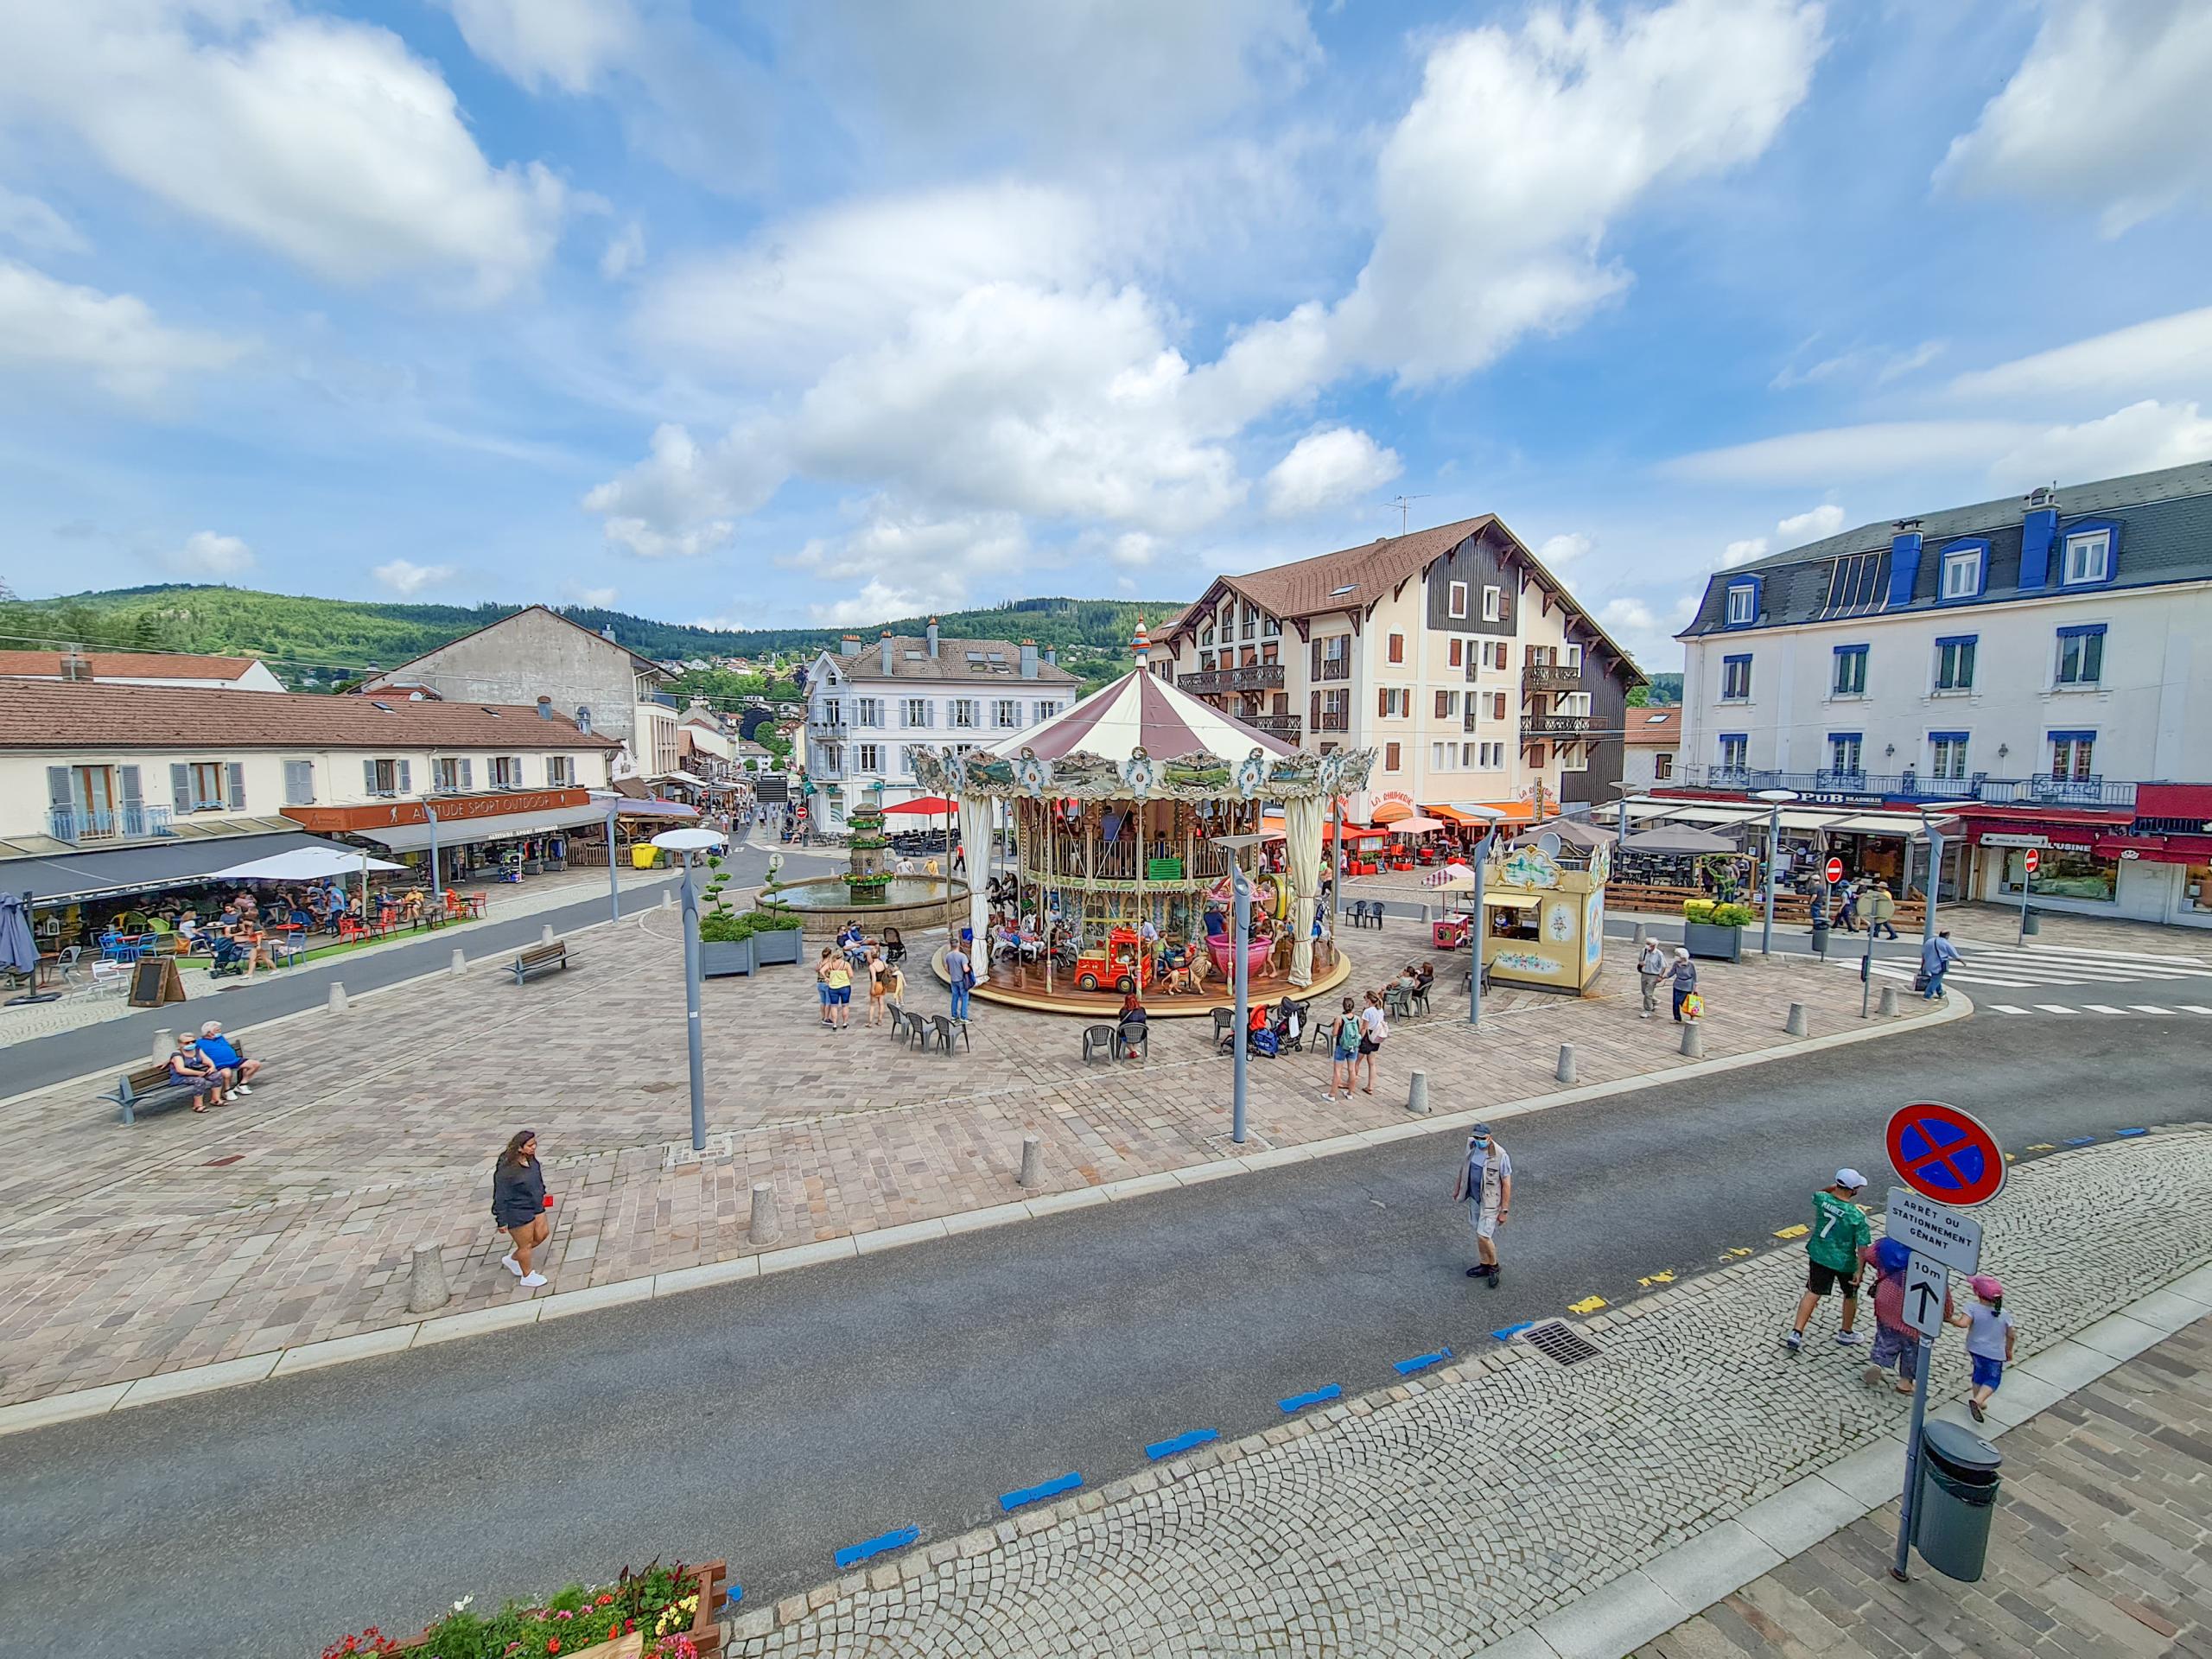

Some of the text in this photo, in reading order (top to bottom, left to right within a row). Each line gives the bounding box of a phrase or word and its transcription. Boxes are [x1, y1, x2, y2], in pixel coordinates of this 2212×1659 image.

[468, 798, 499, 814] SPORT
[503, 795, 550, 810] OUTDOOR
[1370, 791, 1413, 807] LA RHUMERIE
[1800, 792, 1844, 804] PUB
[488, 831, 513, 840] ALTITUDE
[2048, 842, 2092, 852] L'USINE
[1904, 1199, 1960, 1228] ARRÊT OU
[1820, 1211, 1836, 1238] 7
[1892, 1207, 1973, 1247] STATIONNEMENT
[1910, 1227, 1949, 1249] GÊNANT
[1914, 1261, 1941, 1280] 10m
